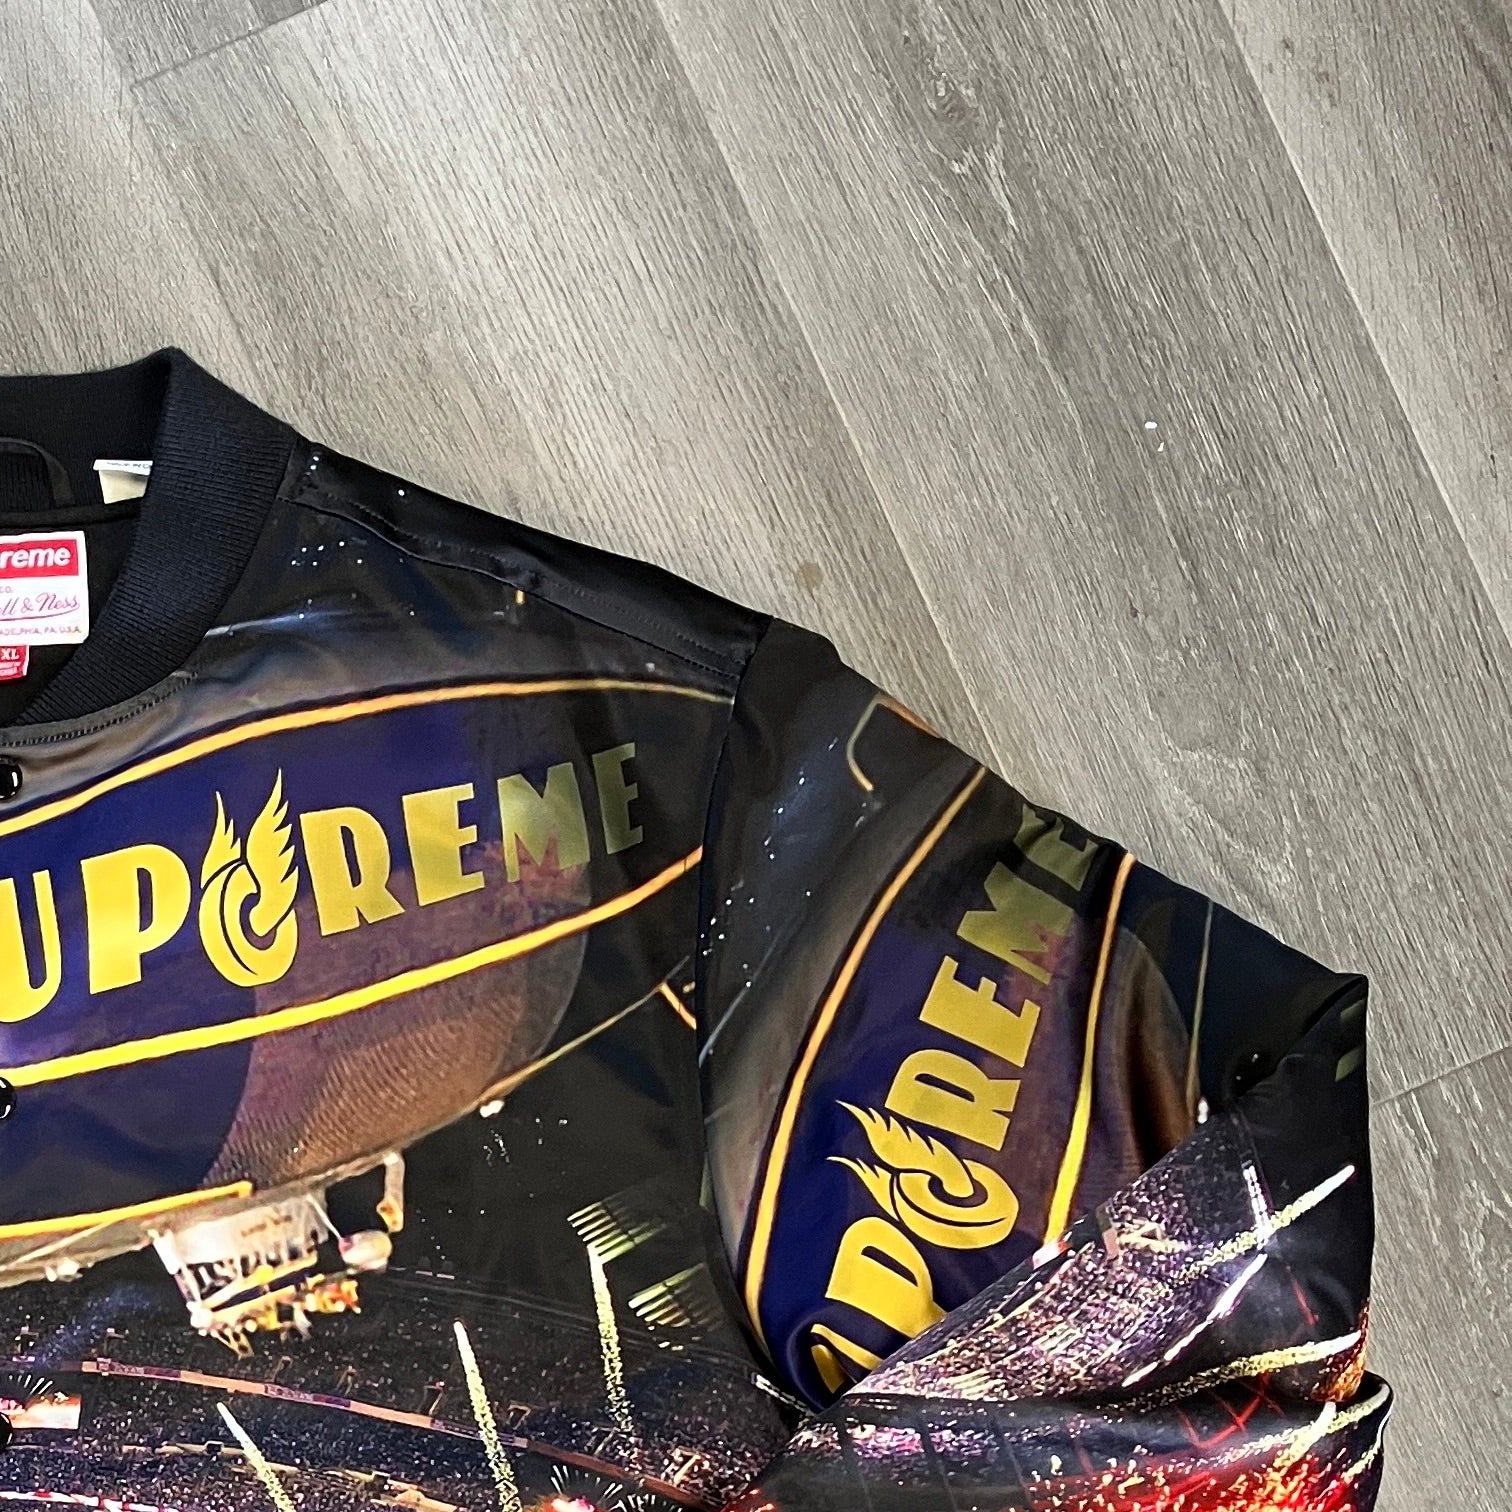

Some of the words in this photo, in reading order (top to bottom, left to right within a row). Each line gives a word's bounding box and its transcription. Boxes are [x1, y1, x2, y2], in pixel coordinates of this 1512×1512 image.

[20, 597, 34, 613] &
[35, 592, 79, 612] Ness
[0, 648, 20, 661] XL
